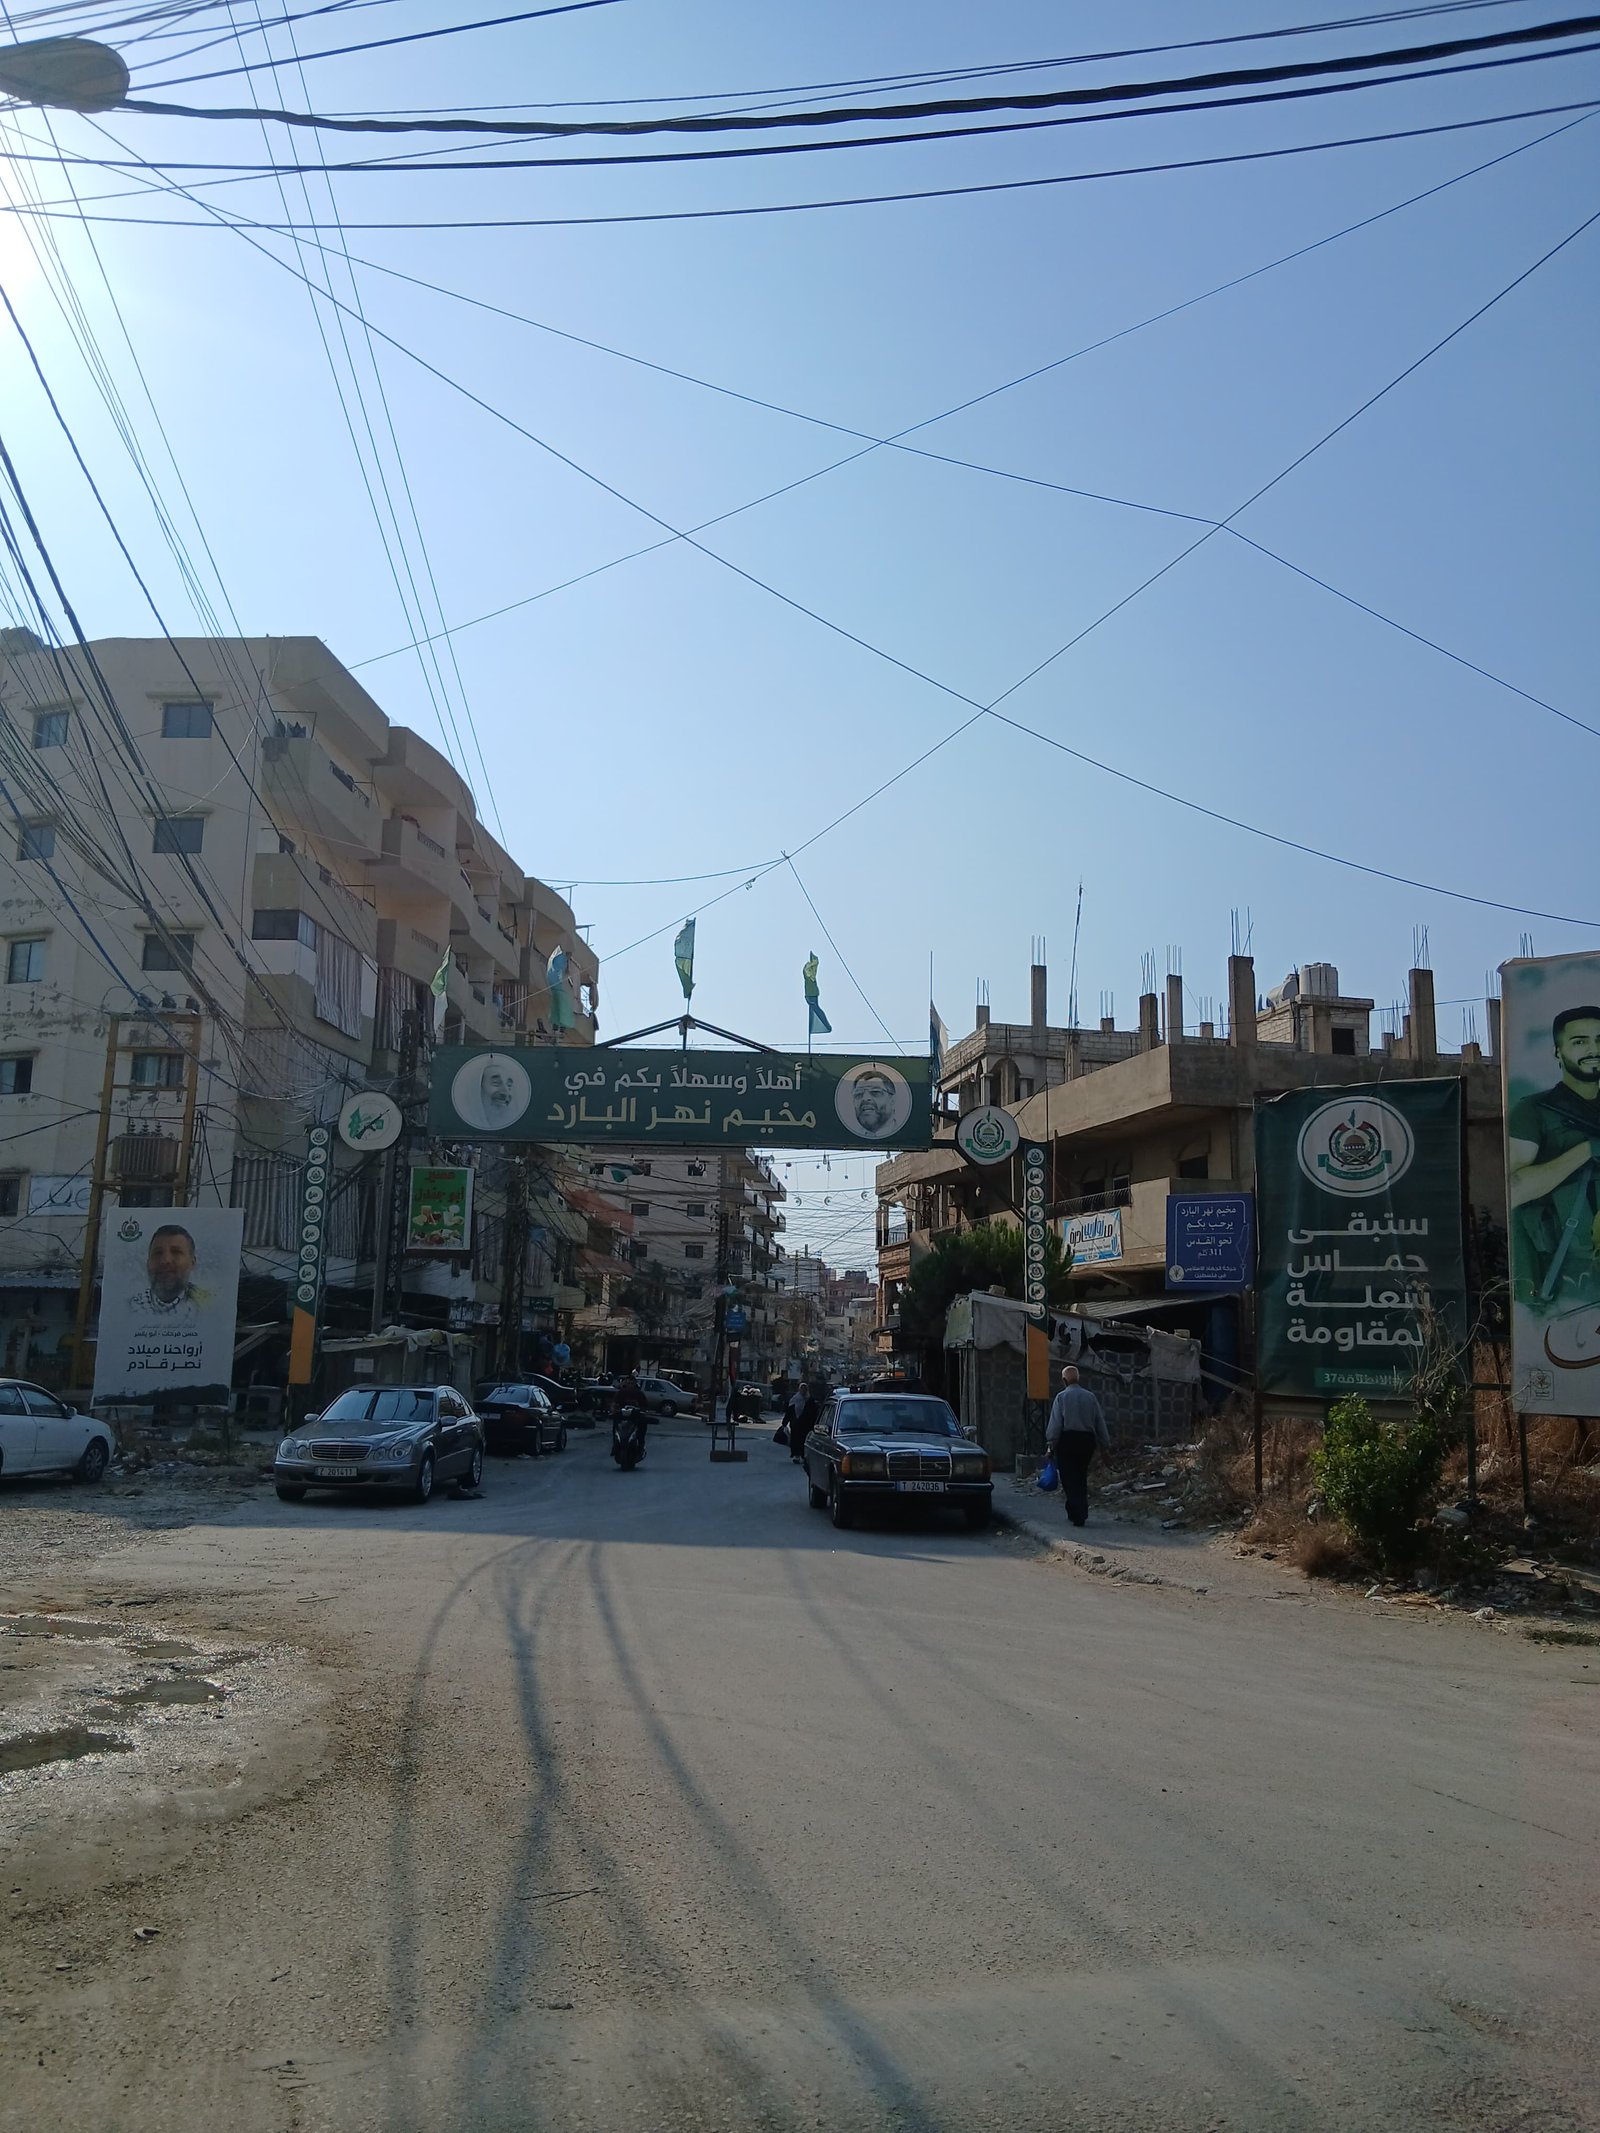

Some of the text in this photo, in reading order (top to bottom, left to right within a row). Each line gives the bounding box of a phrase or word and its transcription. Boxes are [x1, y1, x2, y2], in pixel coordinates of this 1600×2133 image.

[564, 1066, 606, 1096] في
[614, 1067, 662, 1093] بكم
[547, 1096, 817, 1134] مخيم نهر البارد
[1181, 1205, 1237, 1217] مخيم نهر البارد
[1186, 1219, 1233, 1231] يرحب بكم
[1287, 1211, 1429, 1244] ستبقى
[1186, 1236, 1232, 1247] نحو القدس
[1209, 1248, 1222, 1256] 311
[1287, 1249, 1429, 1278] حماس
[1286, 1279, 1430, 1309] شعلة
[128, 1341, 203, 1357] أرواحنا ميلاد
[126, 1358, 201, 1372] نصر قادم
[911, 1481, 940, 1491] 242036
